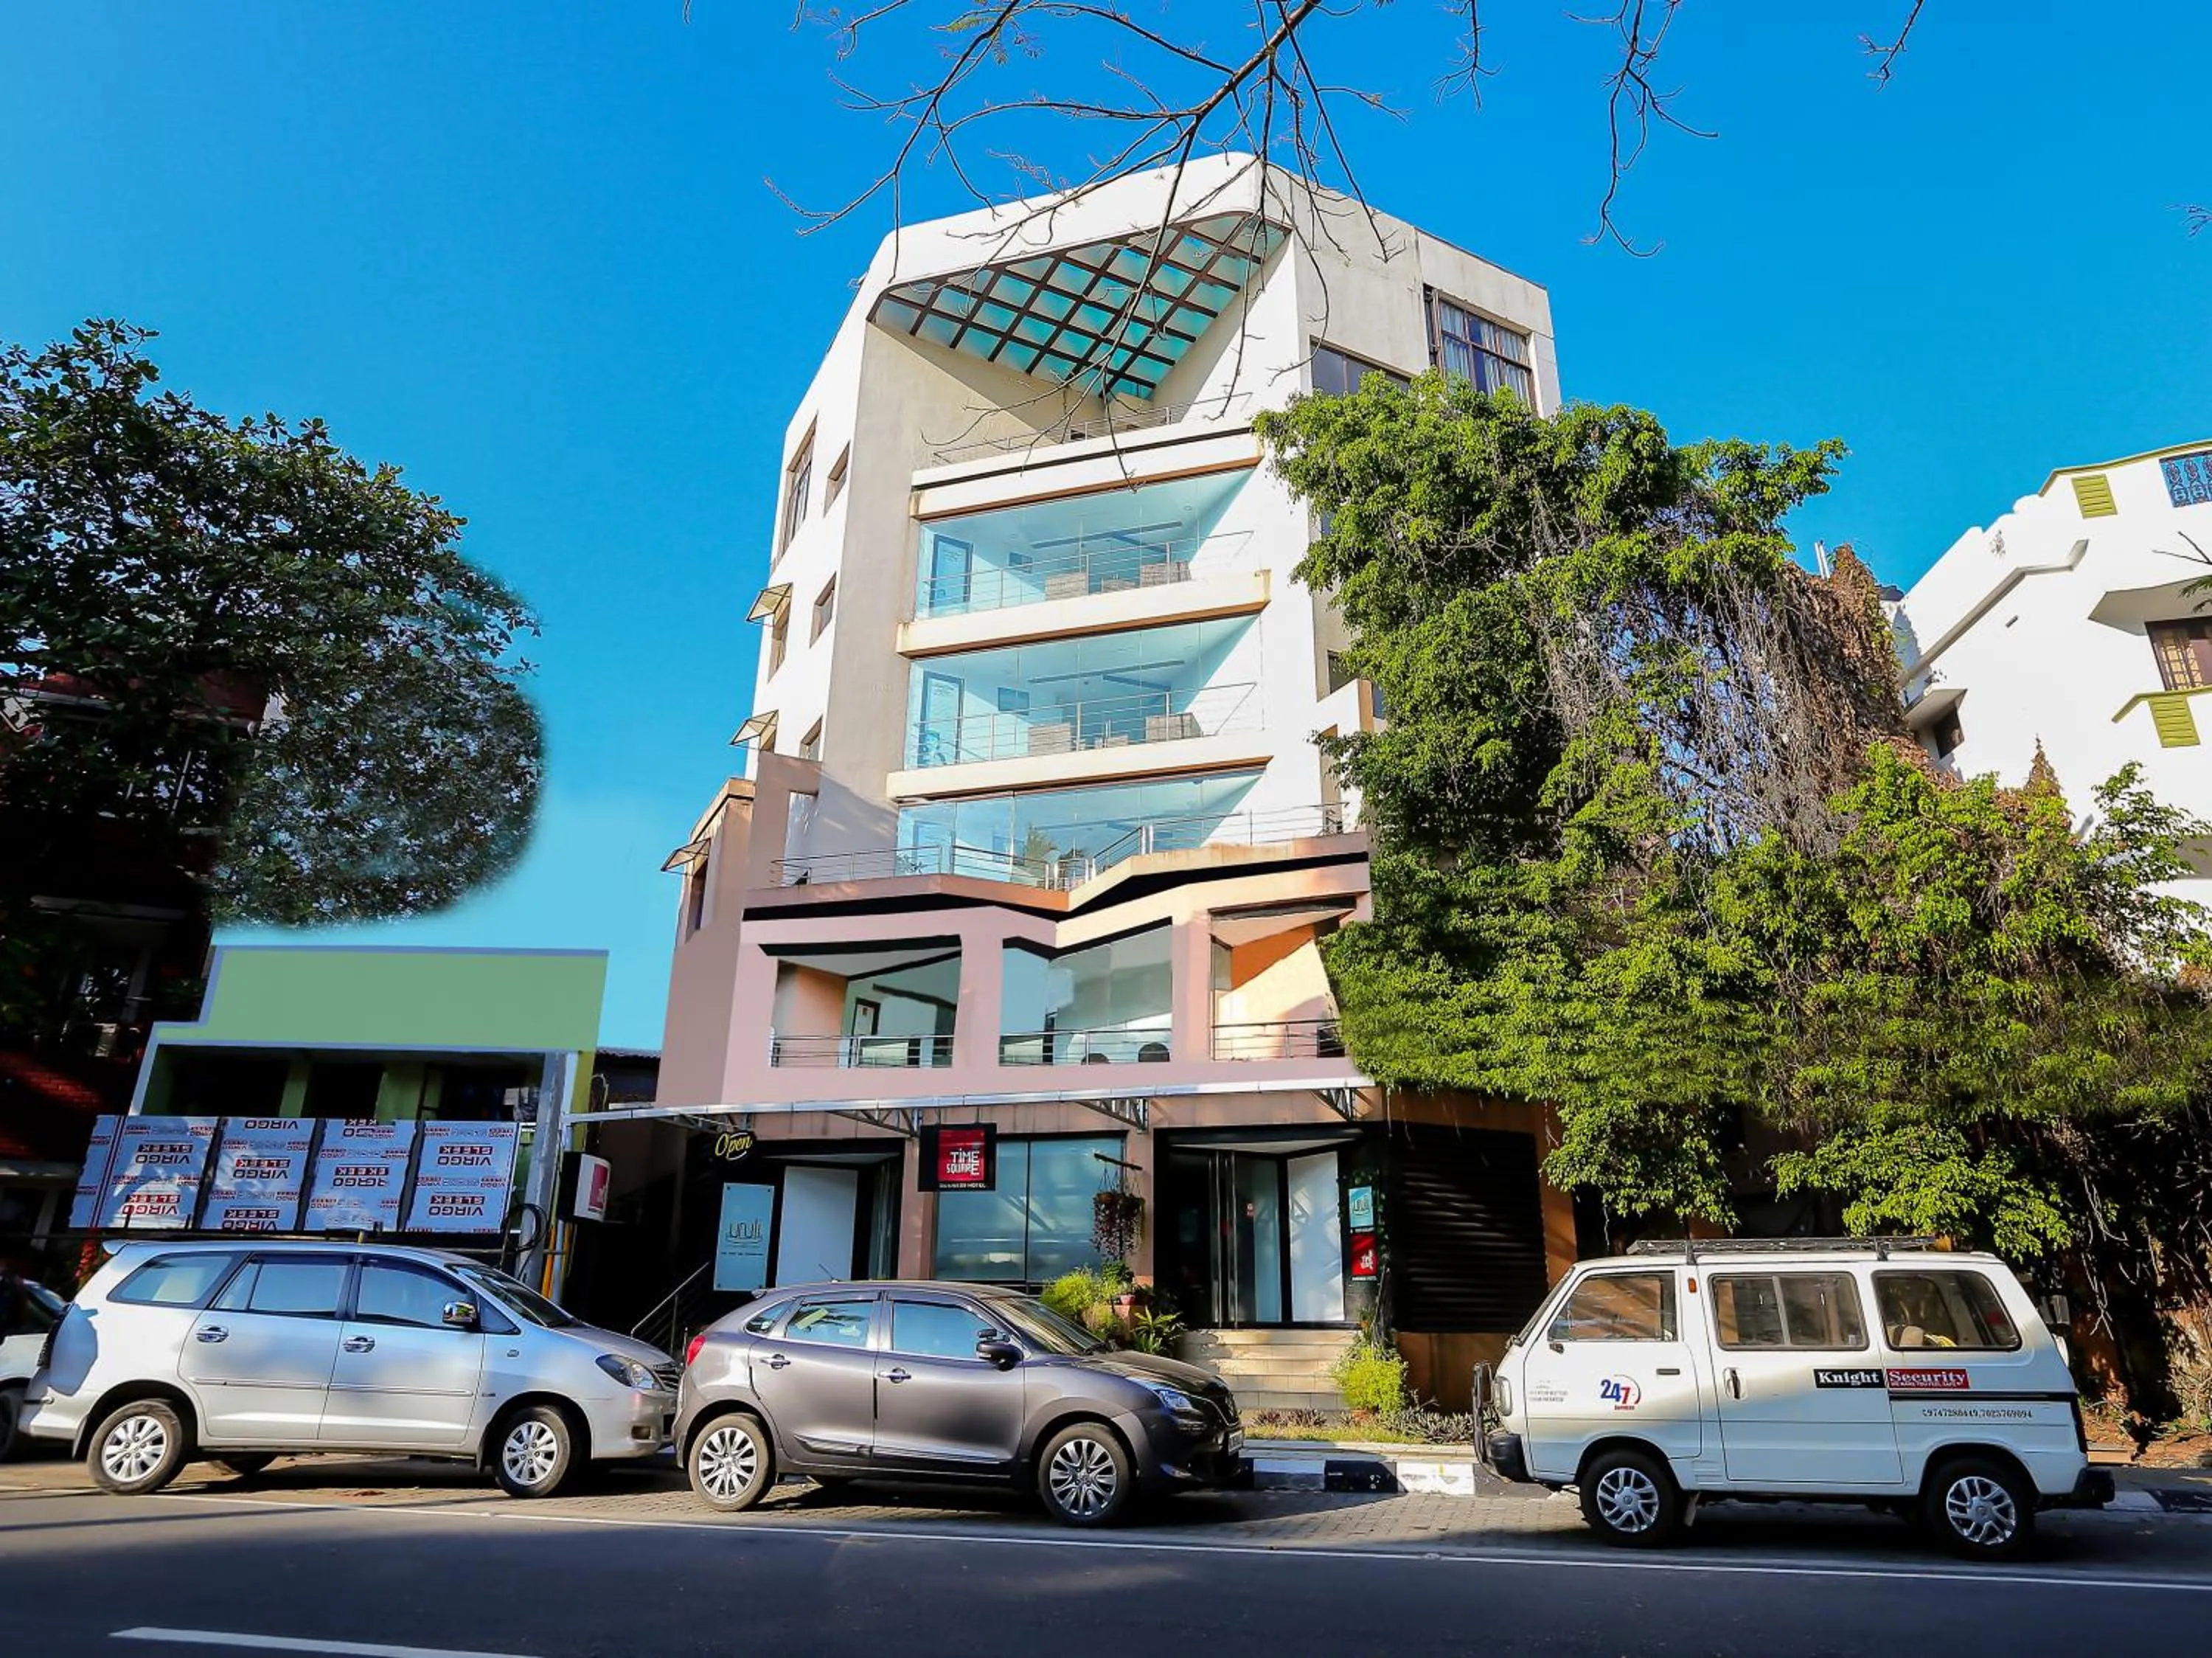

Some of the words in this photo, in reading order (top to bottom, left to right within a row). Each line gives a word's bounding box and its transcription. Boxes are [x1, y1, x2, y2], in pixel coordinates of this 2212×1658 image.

[244, 1120, 299, 1129] VIRGO
[141, 1144, 190, 1152] SLEEK
[443, 1146, 493, 1155] SLEEK
[715, 1133, 752, 1160] Open
[136, 1154, 189, 1164] VIRGO
[950, 1148, 980, 1163] TIME
[240, 1159, 291, 1168] SLEEK
[438, 1156, 492, 1166] VIRGO
[233, 1169, 288, 1179] VIRGO
[129, 1195, 178, 1203] SLEEK
[434, 1196, 484, 1204] SLEEK
[122, 1204, 178, 1215] VIRGO
[227, 1210, 277, 1218] SLEEK
[429, 1206, 484, 1215] VIRGO
[223, 1220, 277, 1230] VIRGO
[1818, 1371, 1879, 1386] Knight
[1888, 1371, 1965, 1385] Security
